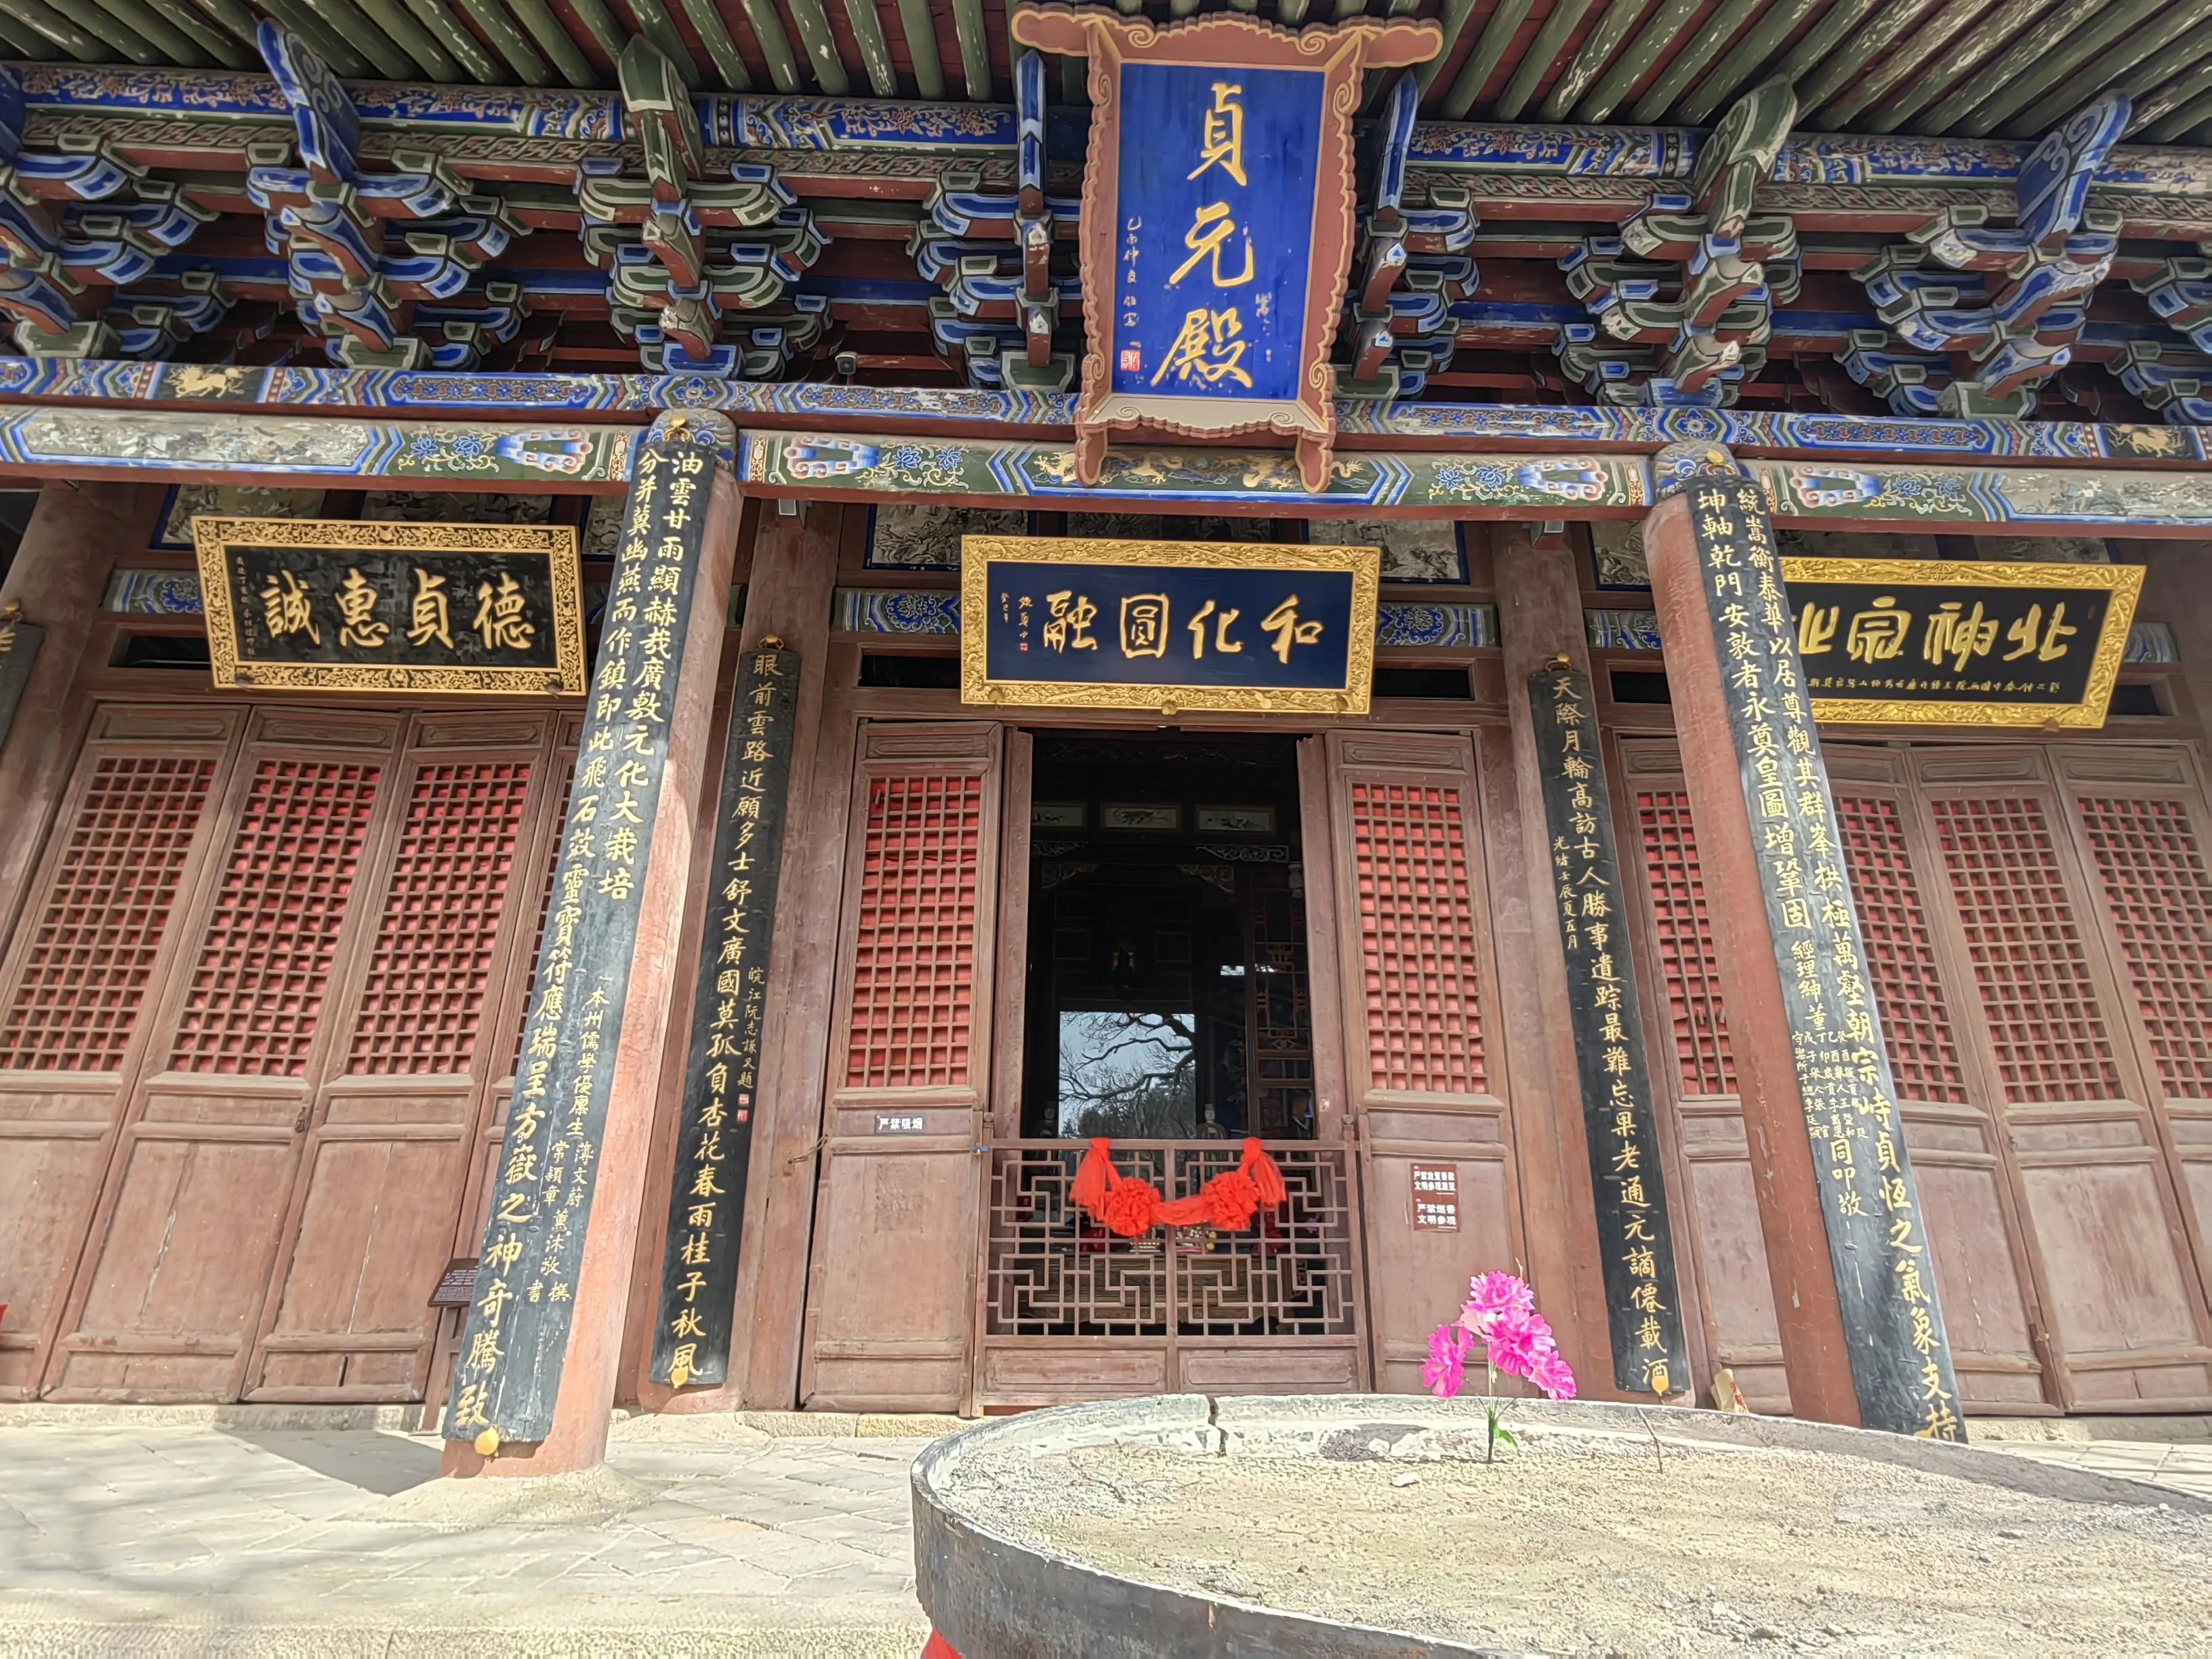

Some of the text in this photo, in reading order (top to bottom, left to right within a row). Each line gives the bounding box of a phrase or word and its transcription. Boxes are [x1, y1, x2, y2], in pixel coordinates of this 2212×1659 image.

[1151, 82, 1254, 389] 貞元殿
[259, 567, 535, 649] 德貞惠誠
[1043, 590, 1324, 663] 和化圓融
[1553, 836, 1578, 949] 光緒壬辰夏五月
[668, 654, 783, 1376] 眼前雲路近願多士舒文廣國莫孤負杏花春雨桂子秋風
[878, 1118, 922, 1130] 严禁吸烟
[1418, 1214, 1456, 1225] 文明参观
